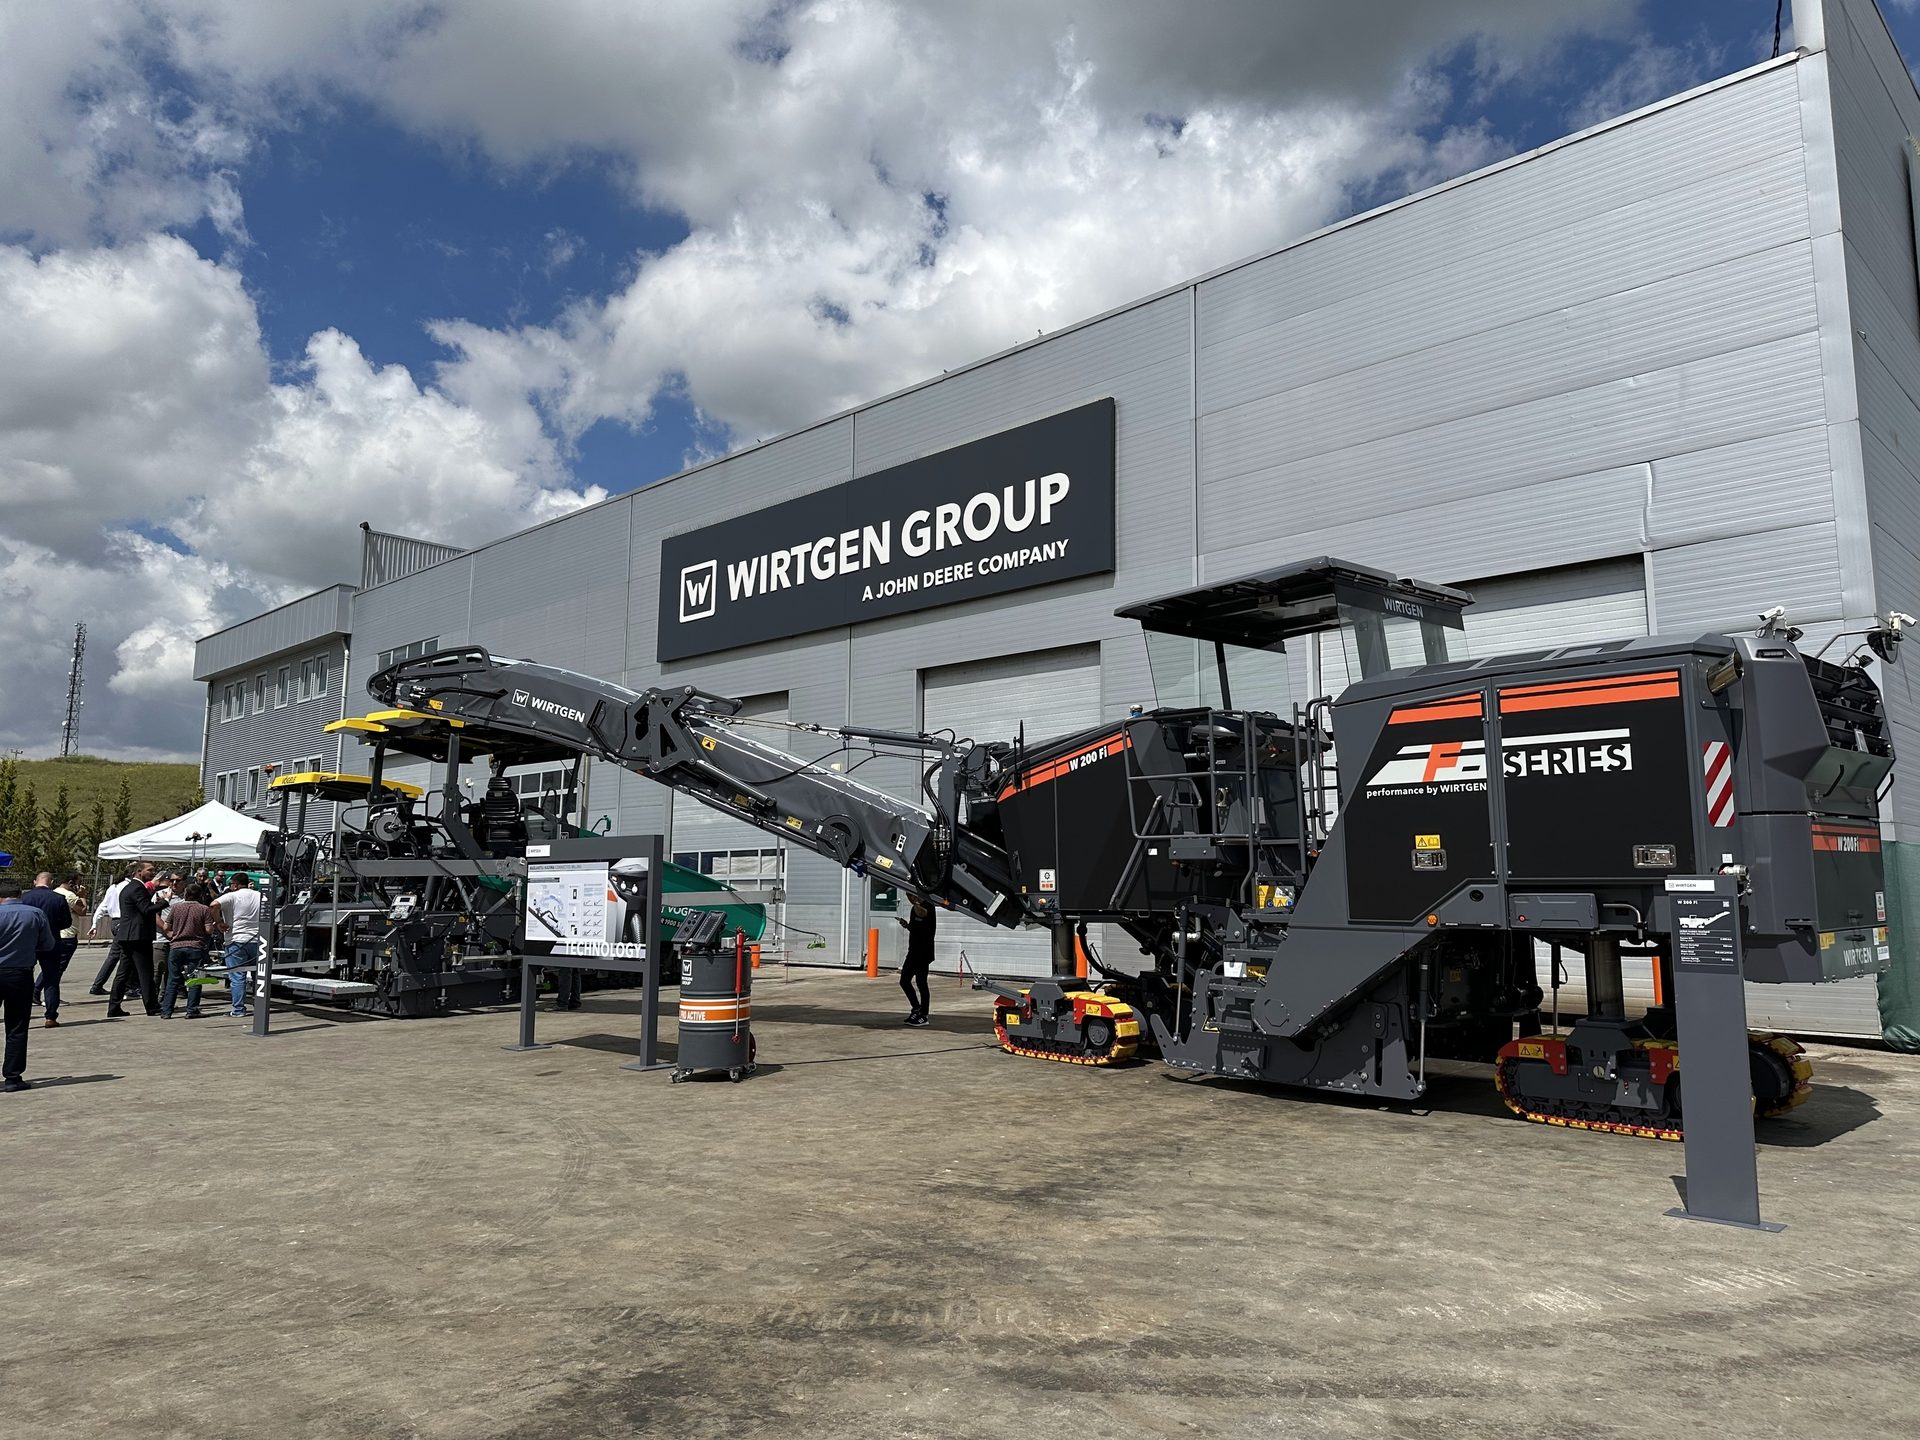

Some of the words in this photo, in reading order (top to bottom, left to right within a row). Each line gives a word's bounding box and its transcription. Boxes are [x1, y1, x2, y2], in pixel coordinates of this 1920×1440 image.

[727, 520, 891, 601] WIRTGEN
[901, 472, 1070, 557] GROUP
[862, 585, 873, 601] A
[876, 574, 918, 598] JOHN
[923, 561, 974, 588] DEERE
[977, 539, 1070, 575] COMPANY
[1383, 597, 1424, 618] WIRTGEN
[531, 696, 586, 723] WIRTGEN
[1070, 758, 1079, 771] W
[1080, 751, 1098, 768] 200
[1098, 745, 1108, 760] Fi
[1366, 787, 1424, 799] performance
[1426, 785, 1438, 796] by
[1440, 782, 1487, 793] WIRTGEN
[1843, 836, 1854, 852] 200
[564, 941, 642, 959] TECHNOLOGY
[1843, 947, 1873, 967] WIRTGEN
[256, 935, 268, 998] NEW
[687, 1010, 706, 1020] ACTIVE
